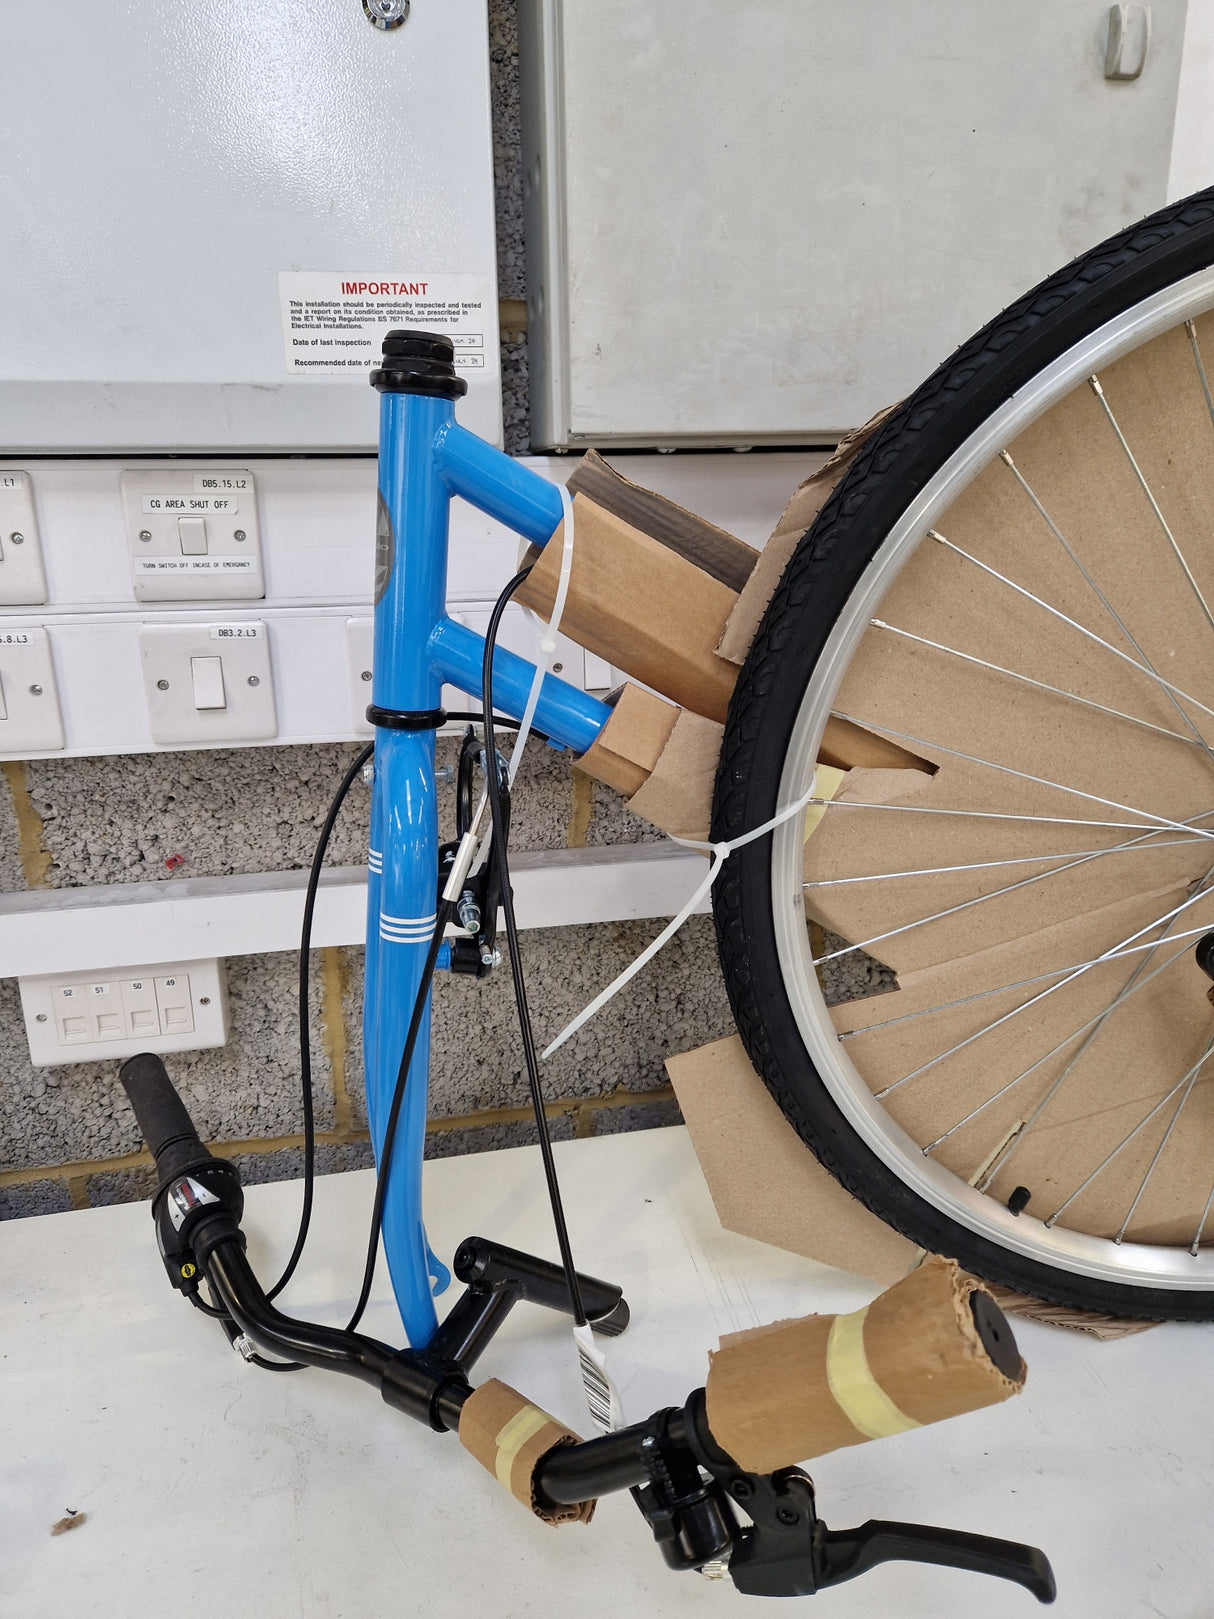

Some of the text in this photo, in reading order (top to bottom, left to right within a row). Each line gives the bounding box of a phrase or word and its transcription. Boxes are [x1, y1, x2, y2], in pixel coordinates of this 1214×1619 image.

[341, 282, 428, 295] IMPORTANT
[335, 339, 371, 347] inspection
[202, 479, 246, 488] DB5.15.L2
[150, 500, 228, 508] CG AREA SHUT OFF
[218, 629, 257, 637] DB3.2.L3
[63, 989, 73, 997] 52
